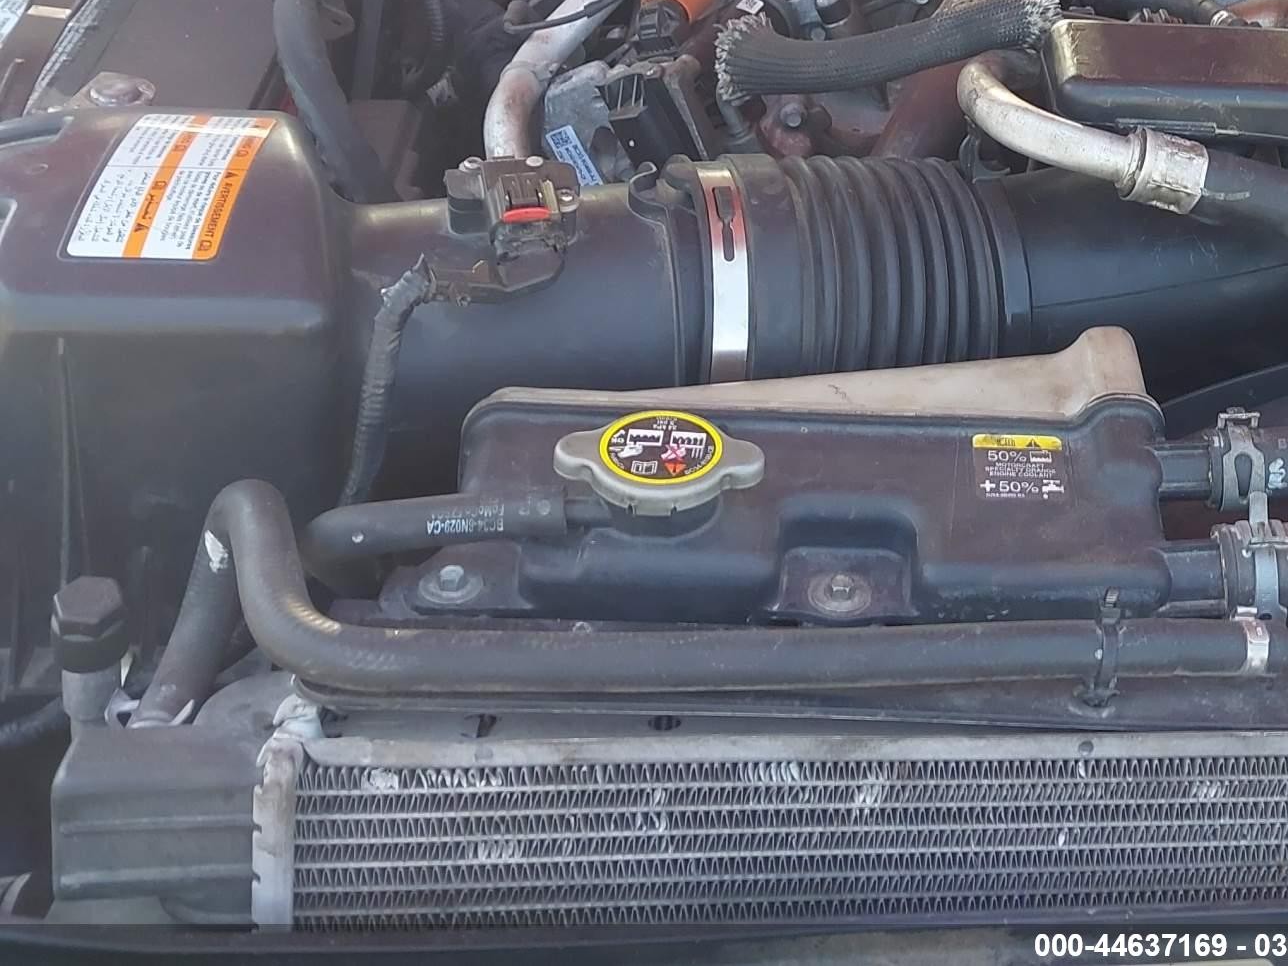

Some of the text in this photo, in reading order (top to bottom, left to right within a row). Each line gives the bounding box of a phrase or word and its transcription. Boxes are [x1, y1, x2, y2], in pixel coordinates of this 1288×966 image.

[204, 182, 233, 238] AVERTISSEMENT
[988, 450, 1027, 462] 50%
[1000, 480, 1039, 493] 50%
